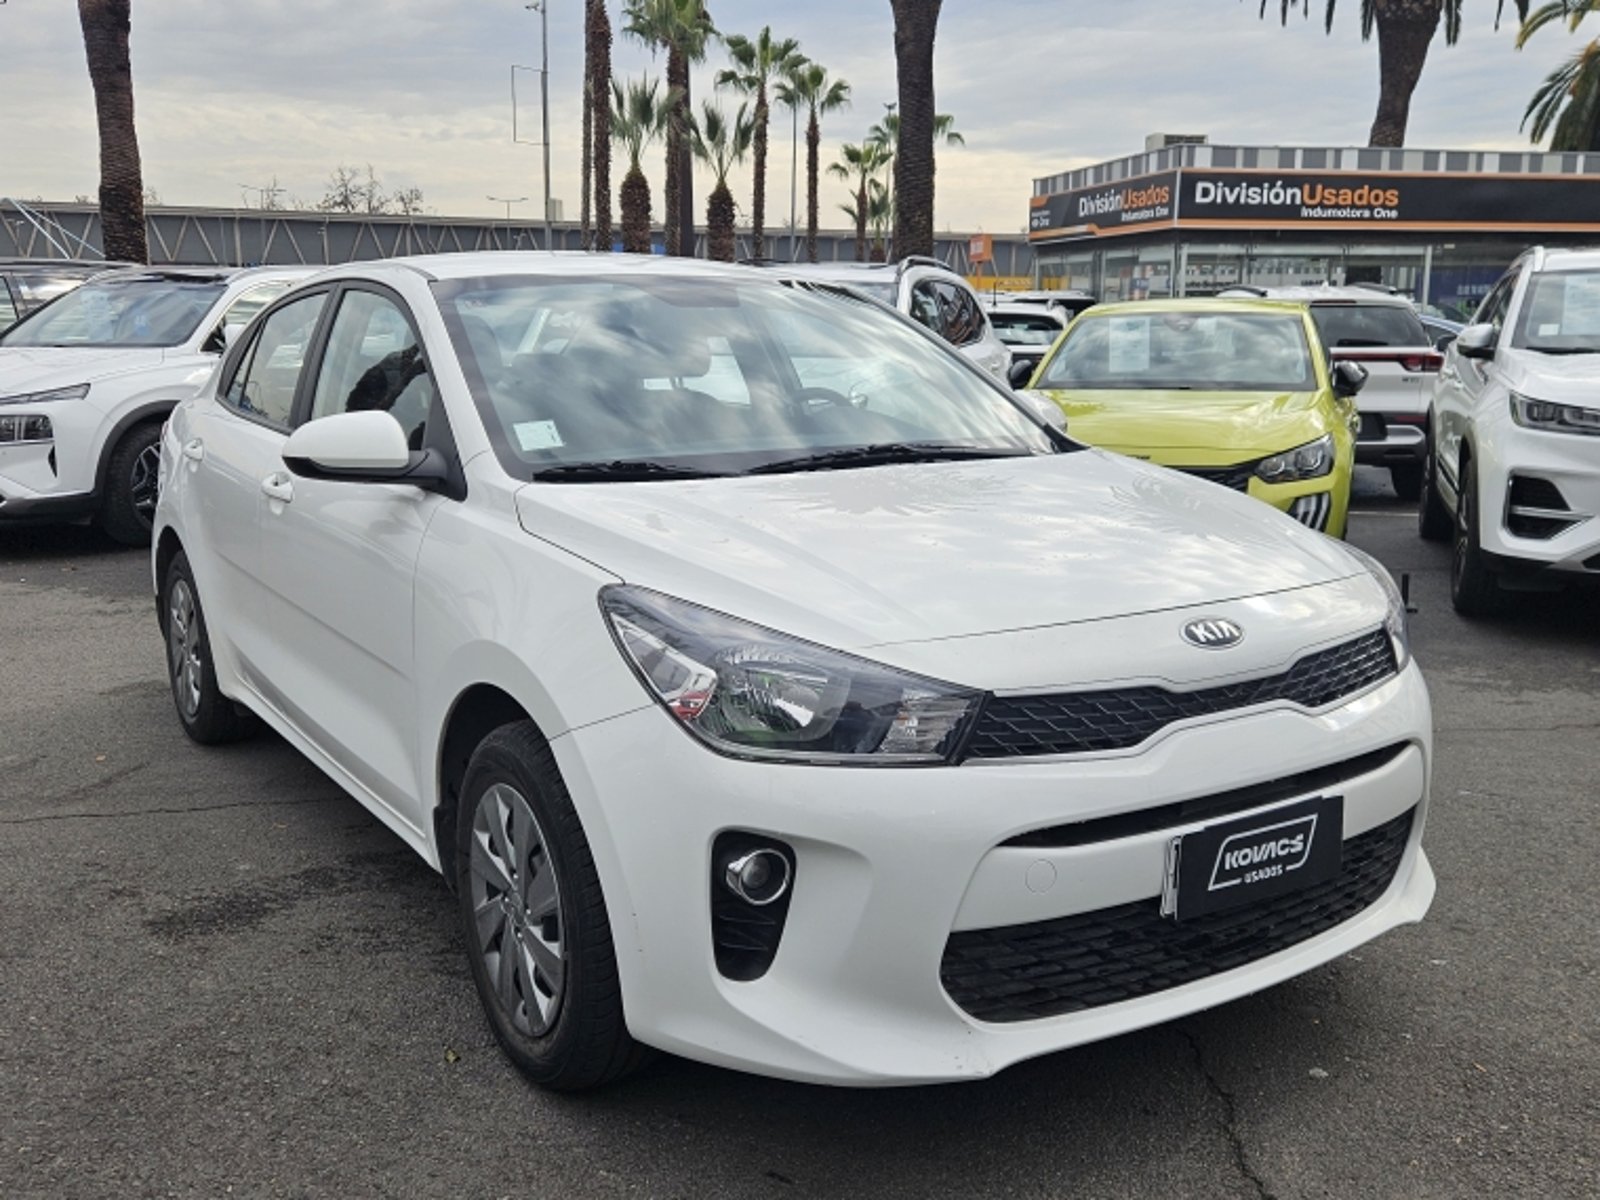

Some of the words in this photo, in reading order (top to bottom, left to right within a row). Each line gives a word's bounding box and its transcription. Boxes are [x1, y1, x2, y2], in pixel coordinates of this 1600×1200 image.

[1301, 206, 1371, 218] Indumotora
[1373, 207, 1399, 219] One
[1190, 621, 1240, 642] KIA
[1224, 833, 1304, 870] KOVACS
[1244, 864, 1283, 883] USADOS
